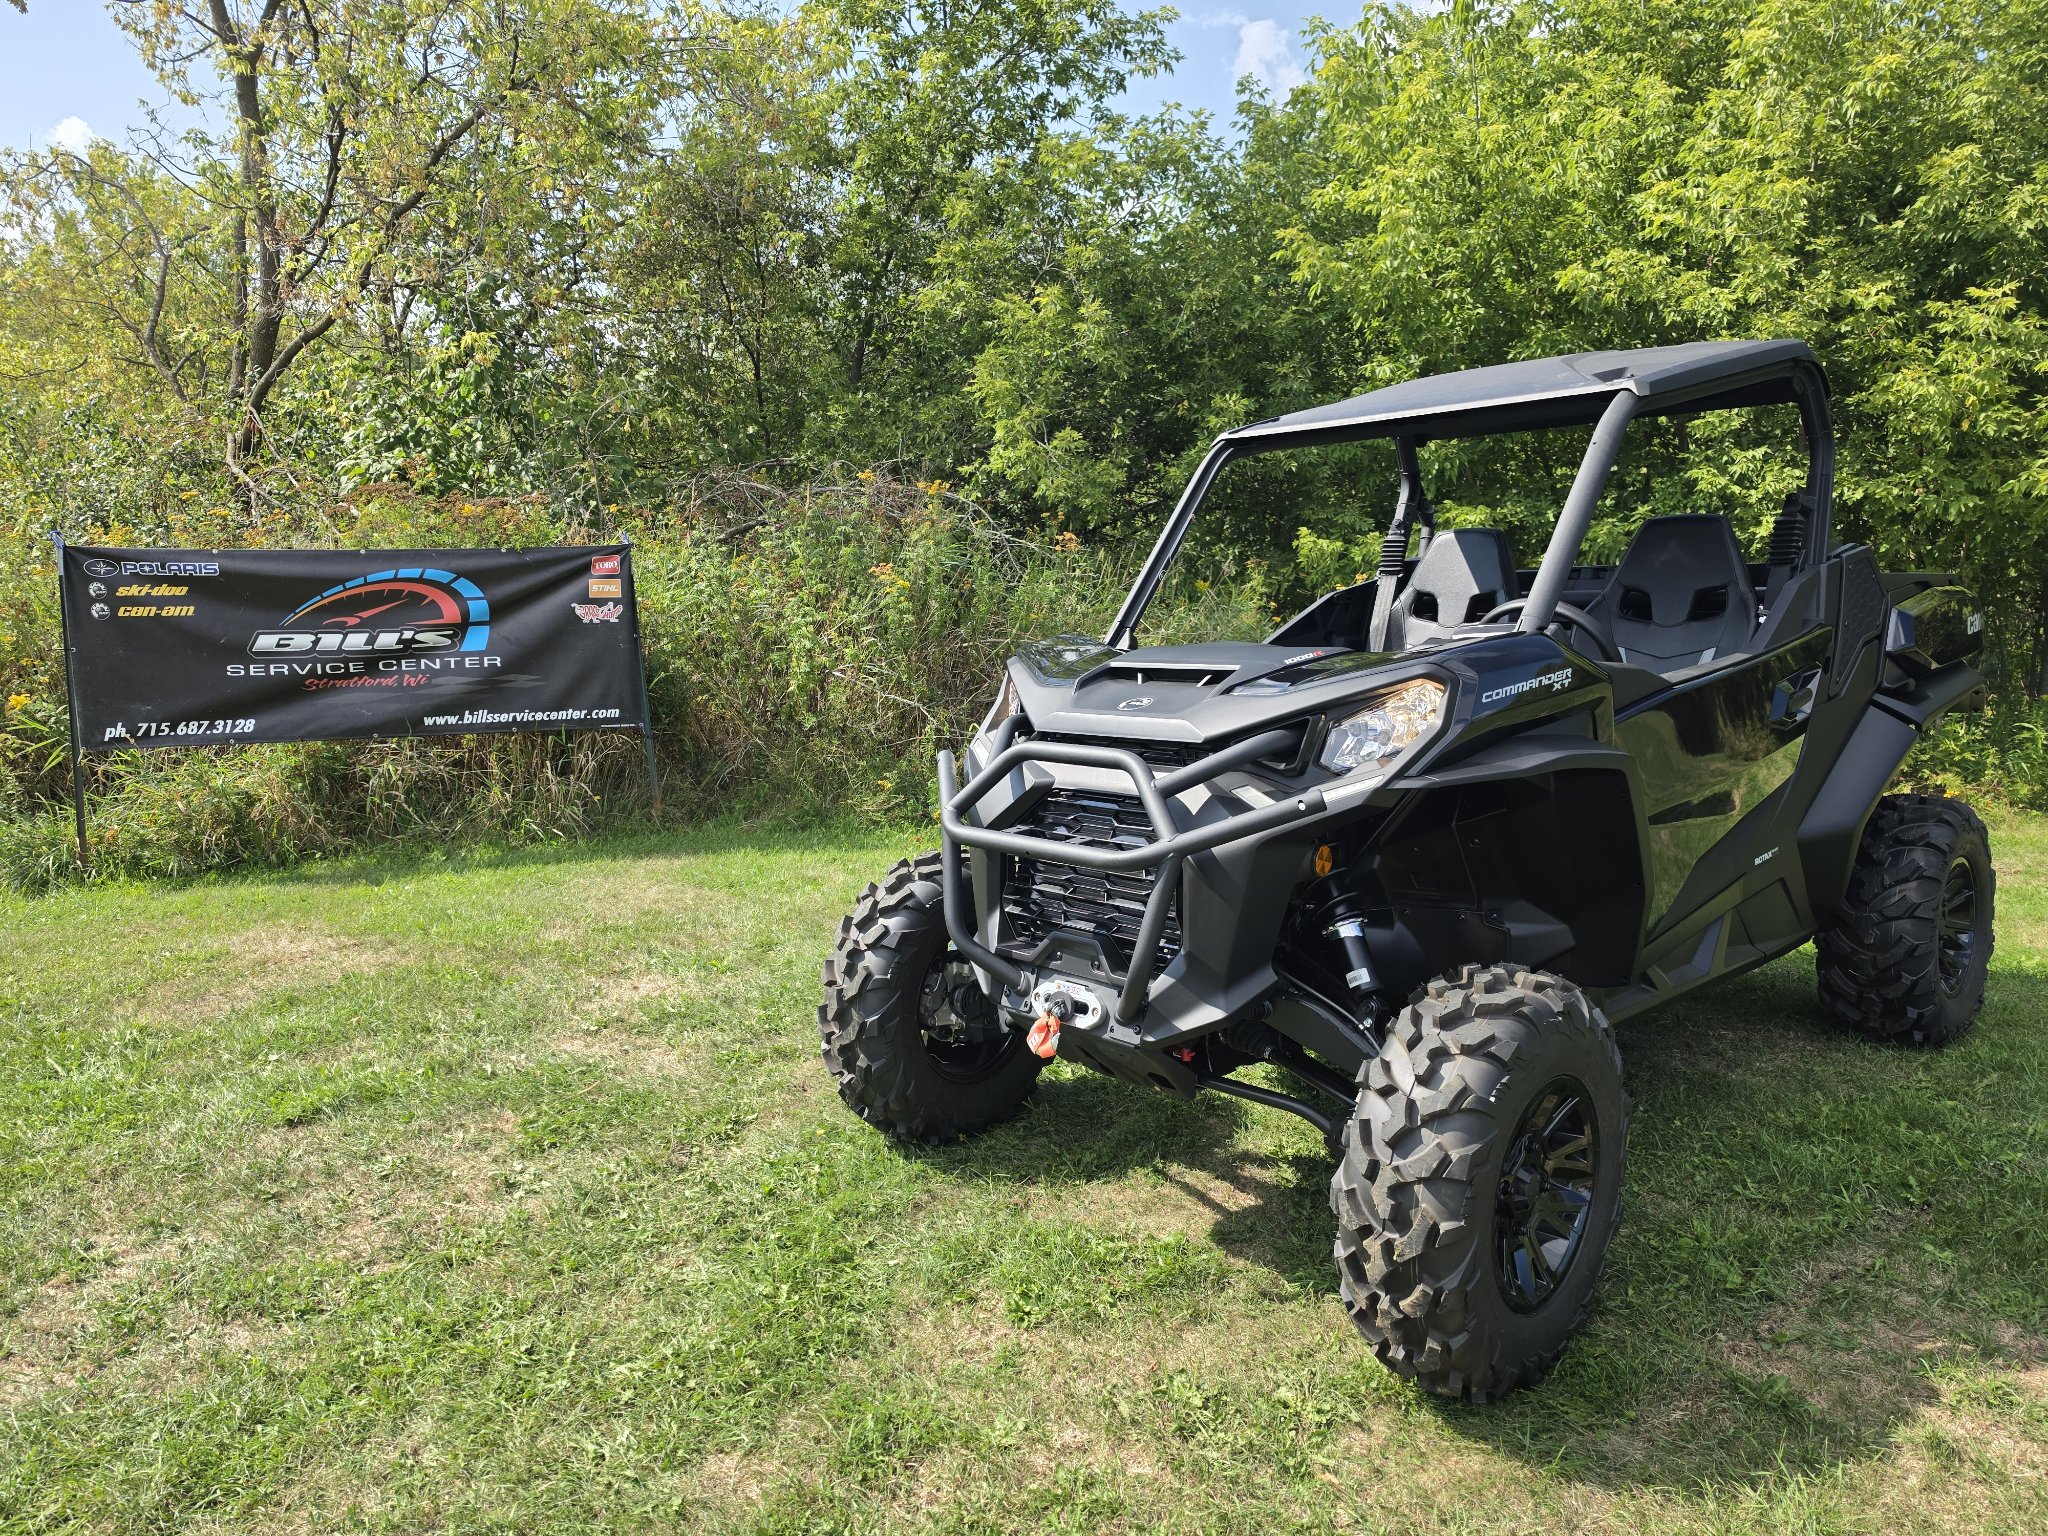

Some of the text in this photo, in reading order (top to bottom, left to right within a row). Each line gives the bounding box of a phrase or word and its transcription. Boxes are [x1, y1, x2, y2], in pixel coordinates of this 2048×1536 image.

[121, 561, 219, 576] POLARIS
[594, 561, 617, 570] TORO
[116, 584, 188, 596] ski-doo
[118, 606, 194, 617] can-am
[226, 656, 502, 677] SERVICE CENTER
[302, 673, 430, 692] Stratford, Wi
[1482, 668, 1573, 703] COMMANDER
[1552, 678, 1572, 692] XT
[424, 708, 620, 726] www.billsservicecenter.com
[104, 719, 256, 741] ph. 715.687.3128
[1754, 850, 1772, 866] ROTAX
